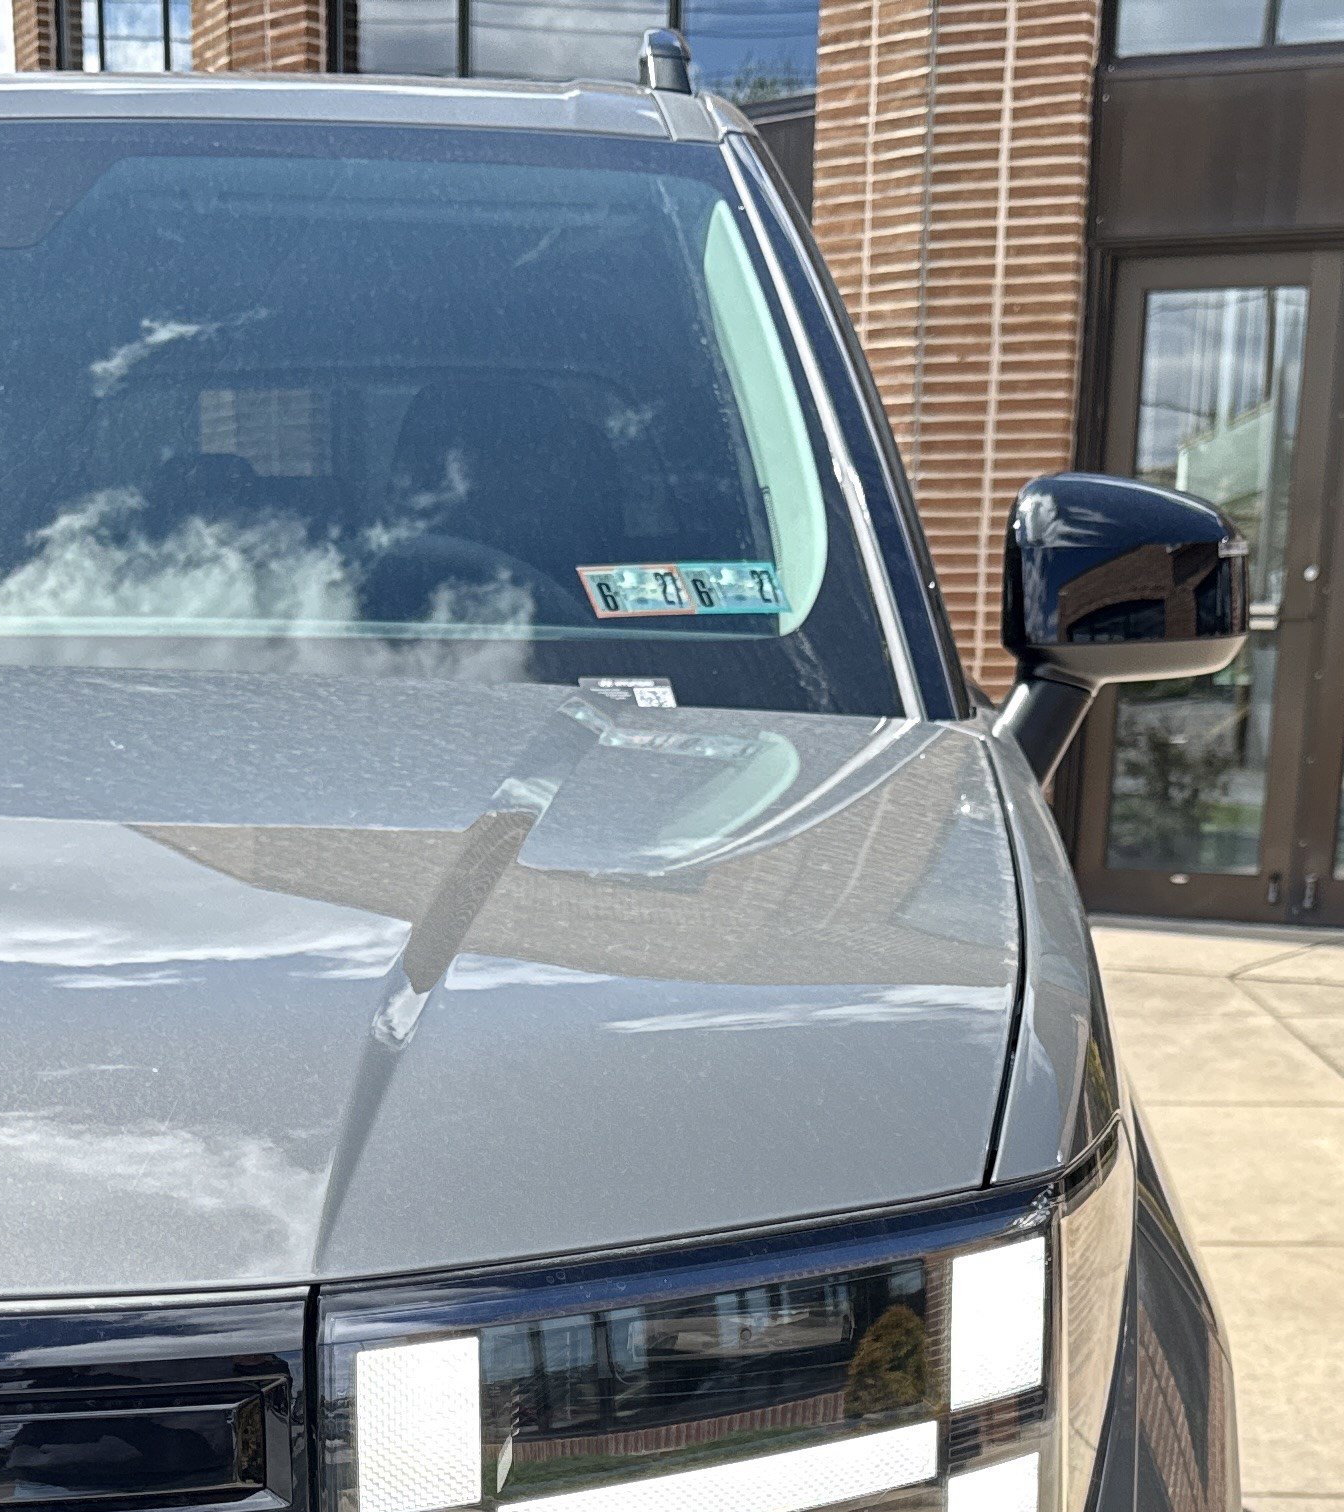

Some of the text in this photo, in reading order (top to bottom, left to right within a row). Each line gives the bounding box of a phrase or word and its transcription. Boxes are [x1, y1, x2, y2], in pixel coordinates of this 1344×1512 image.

[596, 571, 685, 612] 6 27
[691, 578, 715, 608] 6
